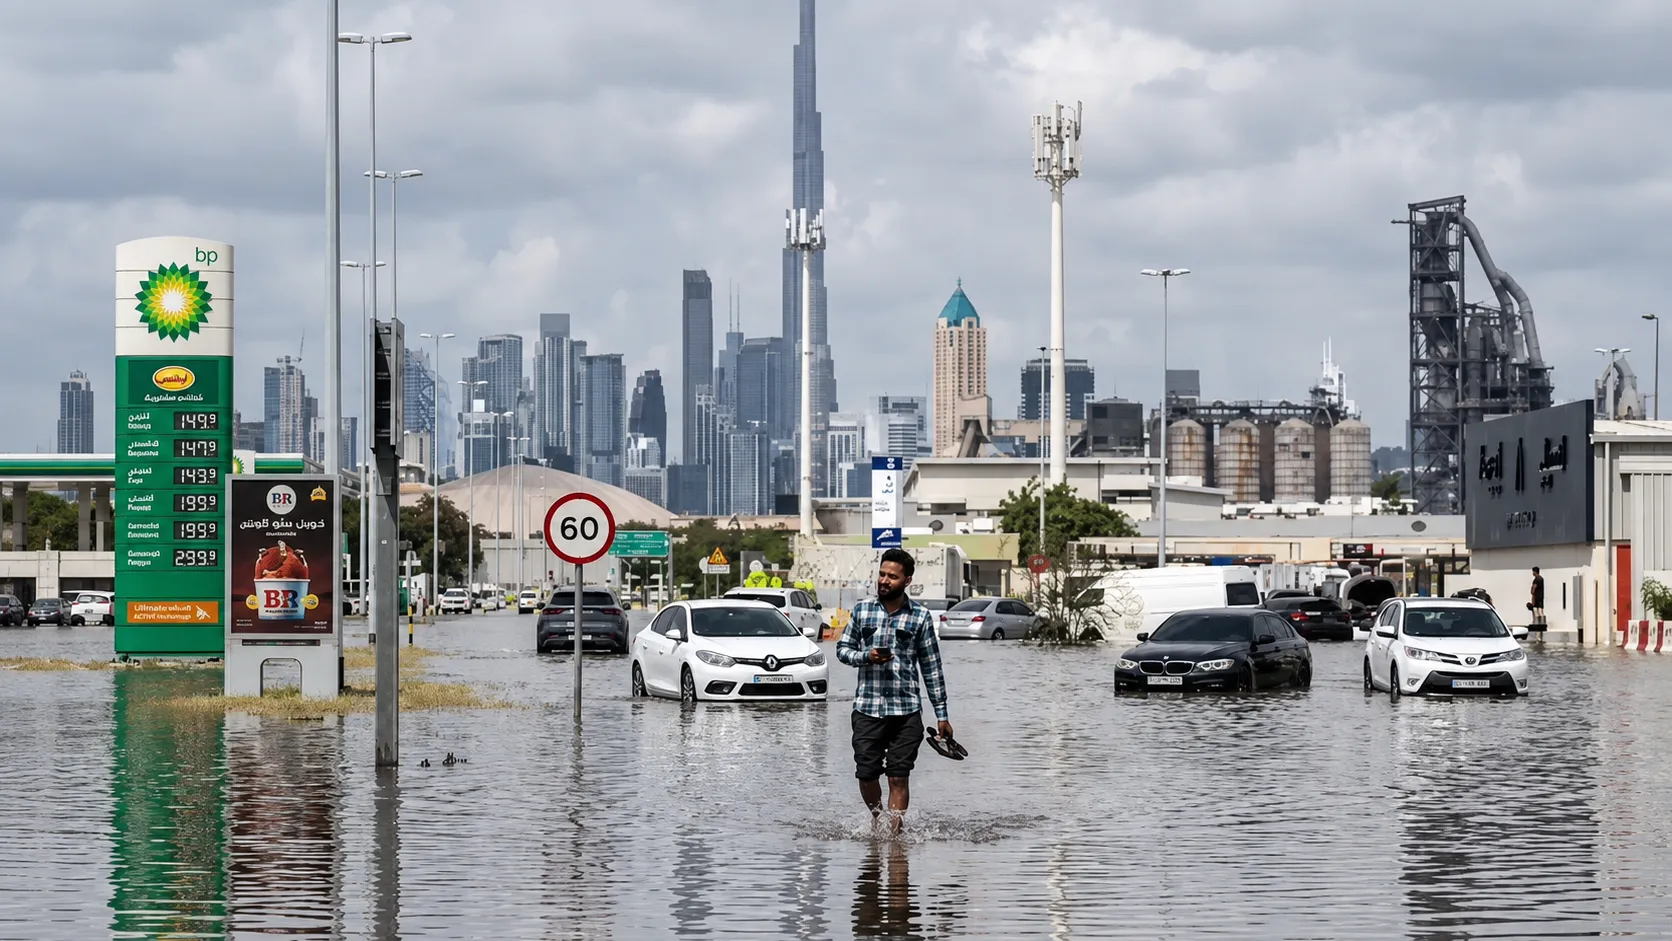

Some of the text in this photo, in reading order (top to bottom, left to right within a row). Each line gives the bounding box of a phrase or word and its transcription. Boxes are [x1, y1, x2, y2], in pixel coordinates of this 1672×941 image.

[195, 247, 218, 266] bp
[271, 493, 292, 505] BR
[560, 516, 599, 541] 60
[263, 590, 299, 609] BR
